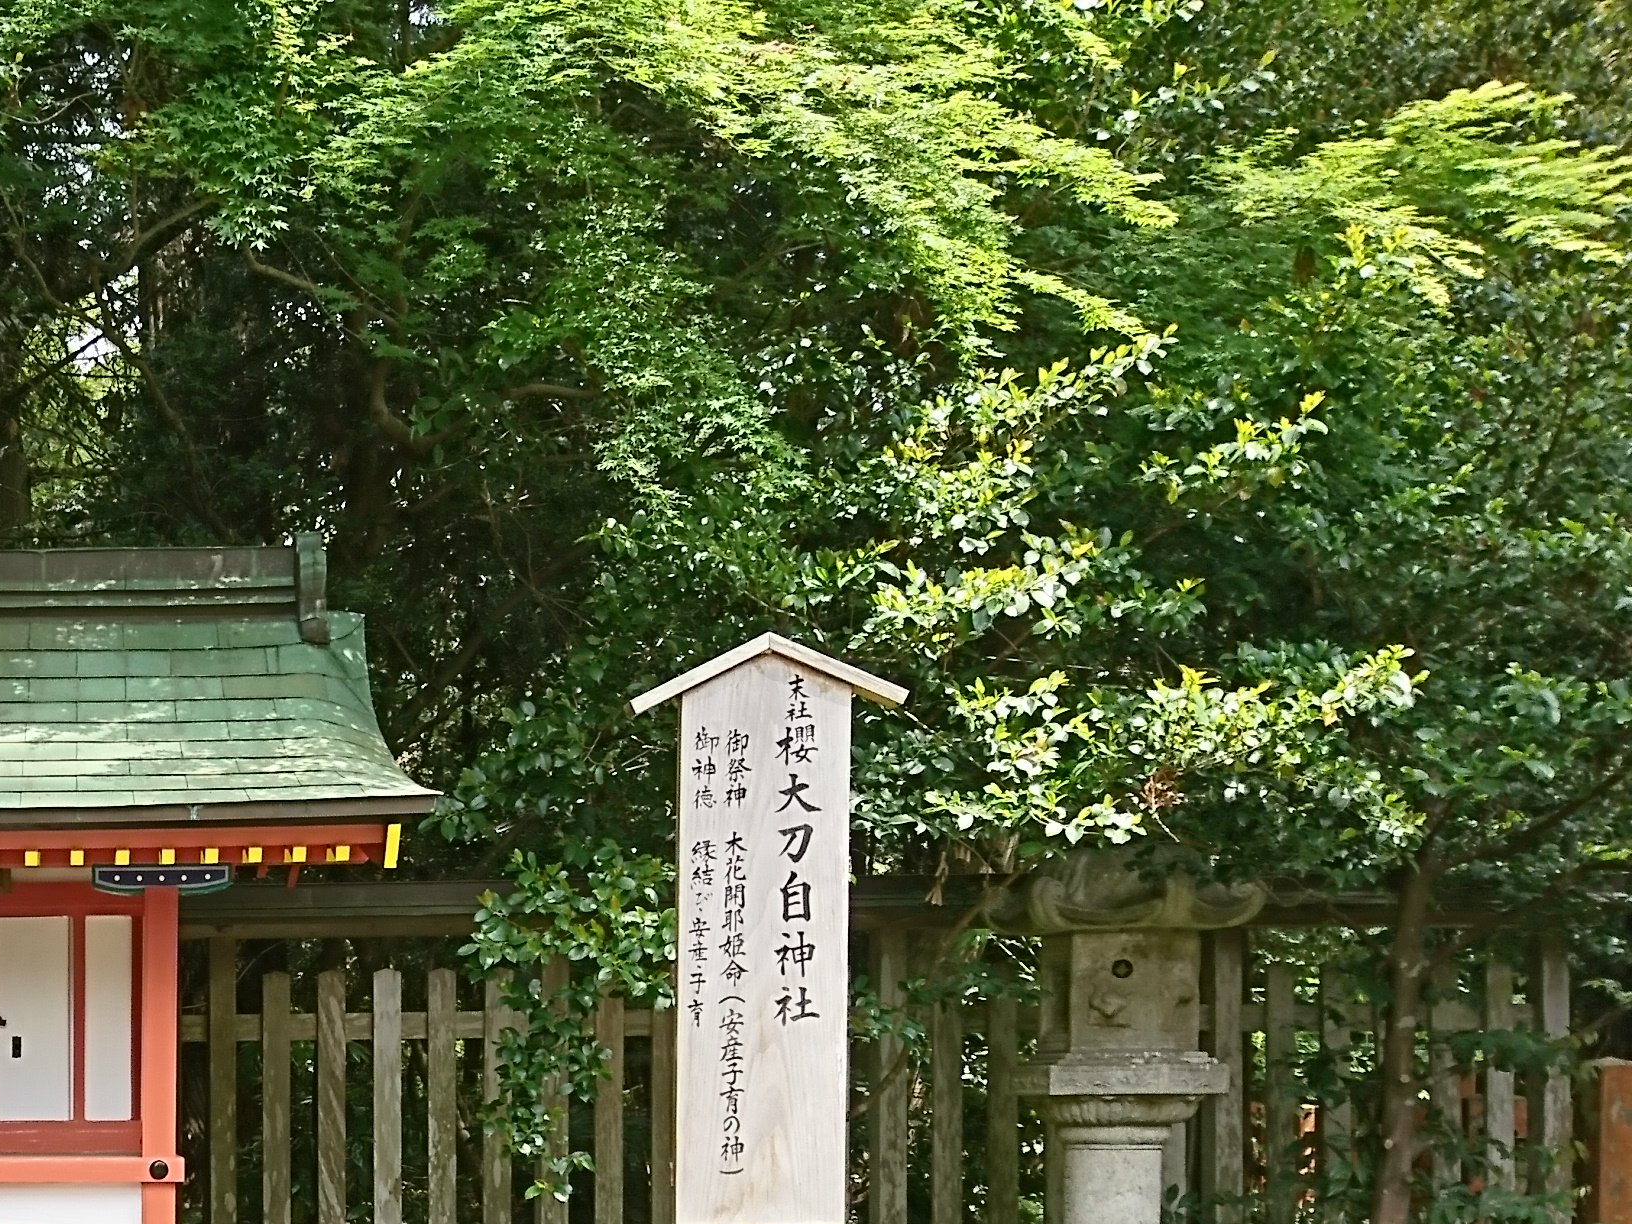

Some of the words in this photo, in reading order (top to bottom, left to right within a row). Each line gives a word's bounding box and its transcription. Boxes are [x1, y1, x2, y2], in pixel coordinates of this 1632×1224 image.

[784, 673, 813, 722] 末社
[691, 725, 720, 810] 御神徳
[723, 729, 752, 809] 御祭神
